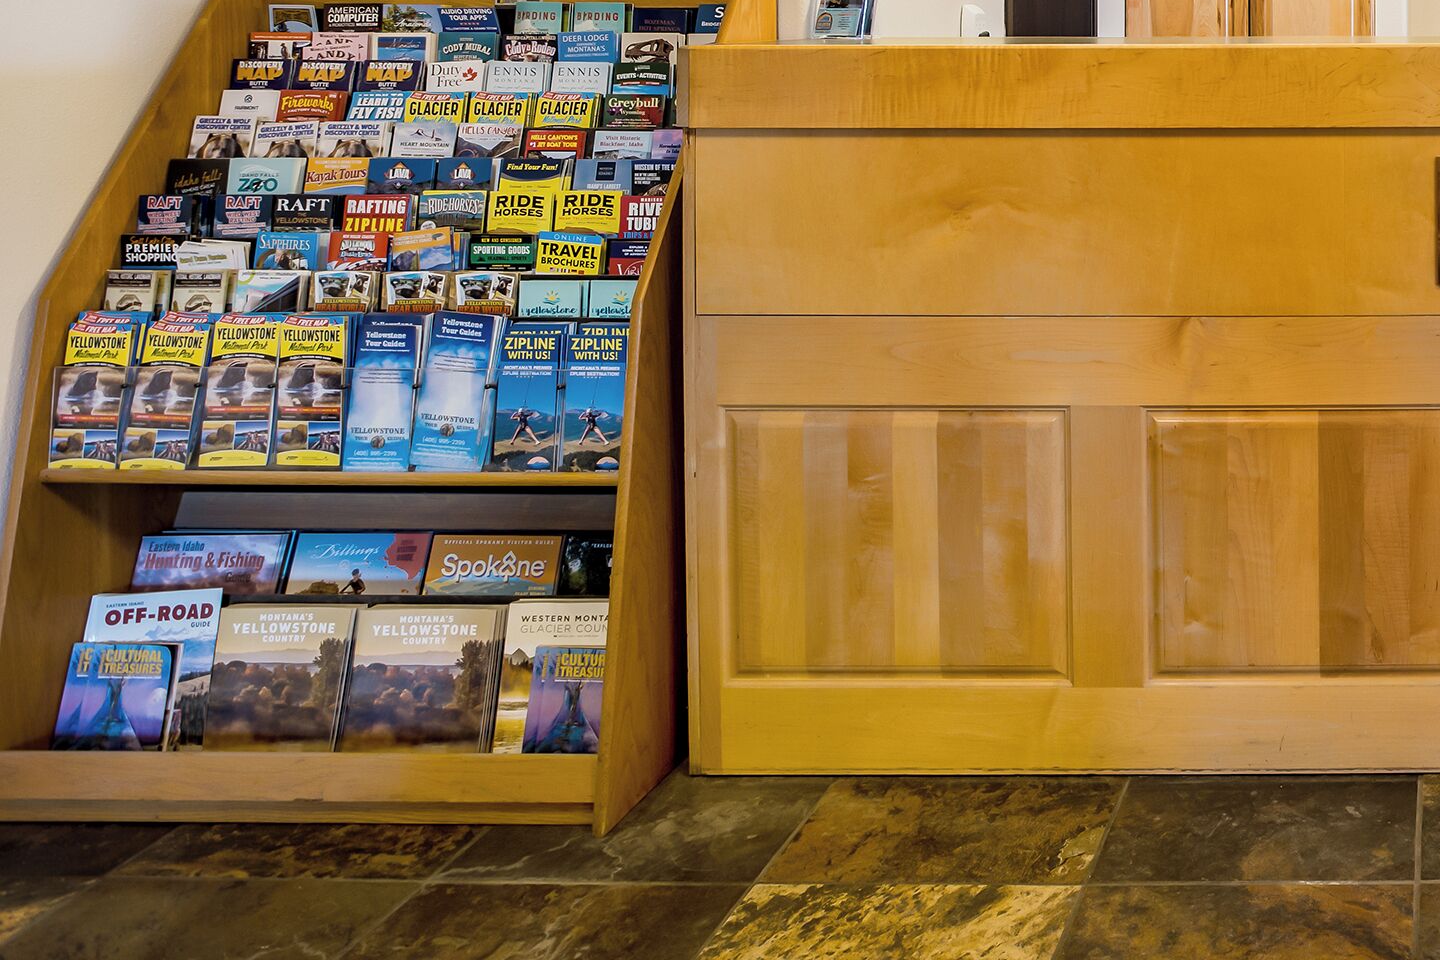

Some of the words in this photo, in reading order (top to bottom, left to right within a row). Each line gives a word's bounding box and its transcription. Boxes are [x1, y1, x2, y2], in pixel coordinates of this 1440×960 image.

[328, 14, 379, 22] COMPUTER
[517, 12, 556, 20] BIRDING
[576, 12, 619, 21] BIRDING
[443, 43, 463, 54] CODY
[465, 43, 491, 55] MURAL
[531, 42, 556, 55] Rodeo
[431, 64, 462, 77] Duty
[494, 67, 536, 76] ENNIS
[558, 67, 600, 77] ENNIS
[437, 77, 462, 87] Free
[282, 96, 334, 111] Fireworks
[357, 98, 388, 106] LEARN
[390, 98, 403, 106] TO
[608, 98, 658, 109] Greybull
[350, 107, 373, 119] FLY
[374, 108, 404, 119] FISH
[410, 102, 458, 115] GLACIER
[474, 102, 522, 116] GLACIER
[540, 102, 587, 116] GLACIER
[174, 174, 199, 188] idaho
[202, 169, 222, 182] falls
[306, 172, 337, 185] Kayak
[339, 169, 367, 180] Tours
[389, 168, 410, 179] LAVA
[454, 169, 472, 179] LAVA
[238, 178, 277, 192] ZOO
[147, 196, 183, 209] RAFT
[226, 196, 262, 209] RAFT
[277, 199, 330, 211] RAFT
[347, 200, 406, 214] RAFTING
[428, 199, 448, 214] RIDE
[449, 198, 480, 213] HORSES
[496, 196, 544, 209] RIDE
[564, 194, 614, 208] RIDE
[494, 208, 543, 217] HORSES
[562, 208, 613, 216] HORSES
[344, 218, 403, 232] ZIPLINE
[260, 234, 311, 250] SAPPHIRES
[554, 234, 588, 242] ONLINE
[473, 246, 506, 254] SPORTING
[508, 246, 530, 254] GOODS
[541, 242, 598, 259] TRAVEL
[541, 257, 595, 268] BROCHURES
[525, 306, 576, 315] yellowstone
[442, 318, 483, 328] Yellowstone
[217, 328, 276, 340] YELLOWSTONE
[283, 330, 340, 342] YELLOWSTONE
[459, 328, 482, 337] Guides
[70, 335, 126, 349] YELLOWSTONE
[149, 335, 204, 349] YELLOWSTONE
[289, 343, 316, 352] National
[316, 343, 333, 352] Park
[504, 338, 556, 350] ZIPLINE
[570, 338, 622, 350] ZIPLINE
[508, 351, 533, 359] WITH
[535, 351, 551, 359] US!
[575, 352, 600, 360] WITH
[602, 352, 618, 360] US!
[420, 413, 475, 424] YELLOWSTONE
[149, 542, 180, 552] Eastern
[182, 541, 205, 552] Idaho
[312, 544, 380, 560] Billings
[144, 553, 202, 571] Hunting
[204, 554, 214, 568] &
[217, 552, 265, 571] Fishing
[441, 551, 545, 582] Spokane
[105, 603, 214, 625] OFF-ROAD
[259, 613, 314, 621] MONTANA'S
[233, 623, 335, 634] YELLOWSTONE
[372, 624, 478, 636] YELLOWSTONE
[520, 624, 571, 633] GLACIER
[262, 635, 305, 643] COUNTRY
[403, 637, 447, 645] COUNTRY
[107, 650, 163, 662] CULTURAL
[105, 663, 162, 674] TREASURES
